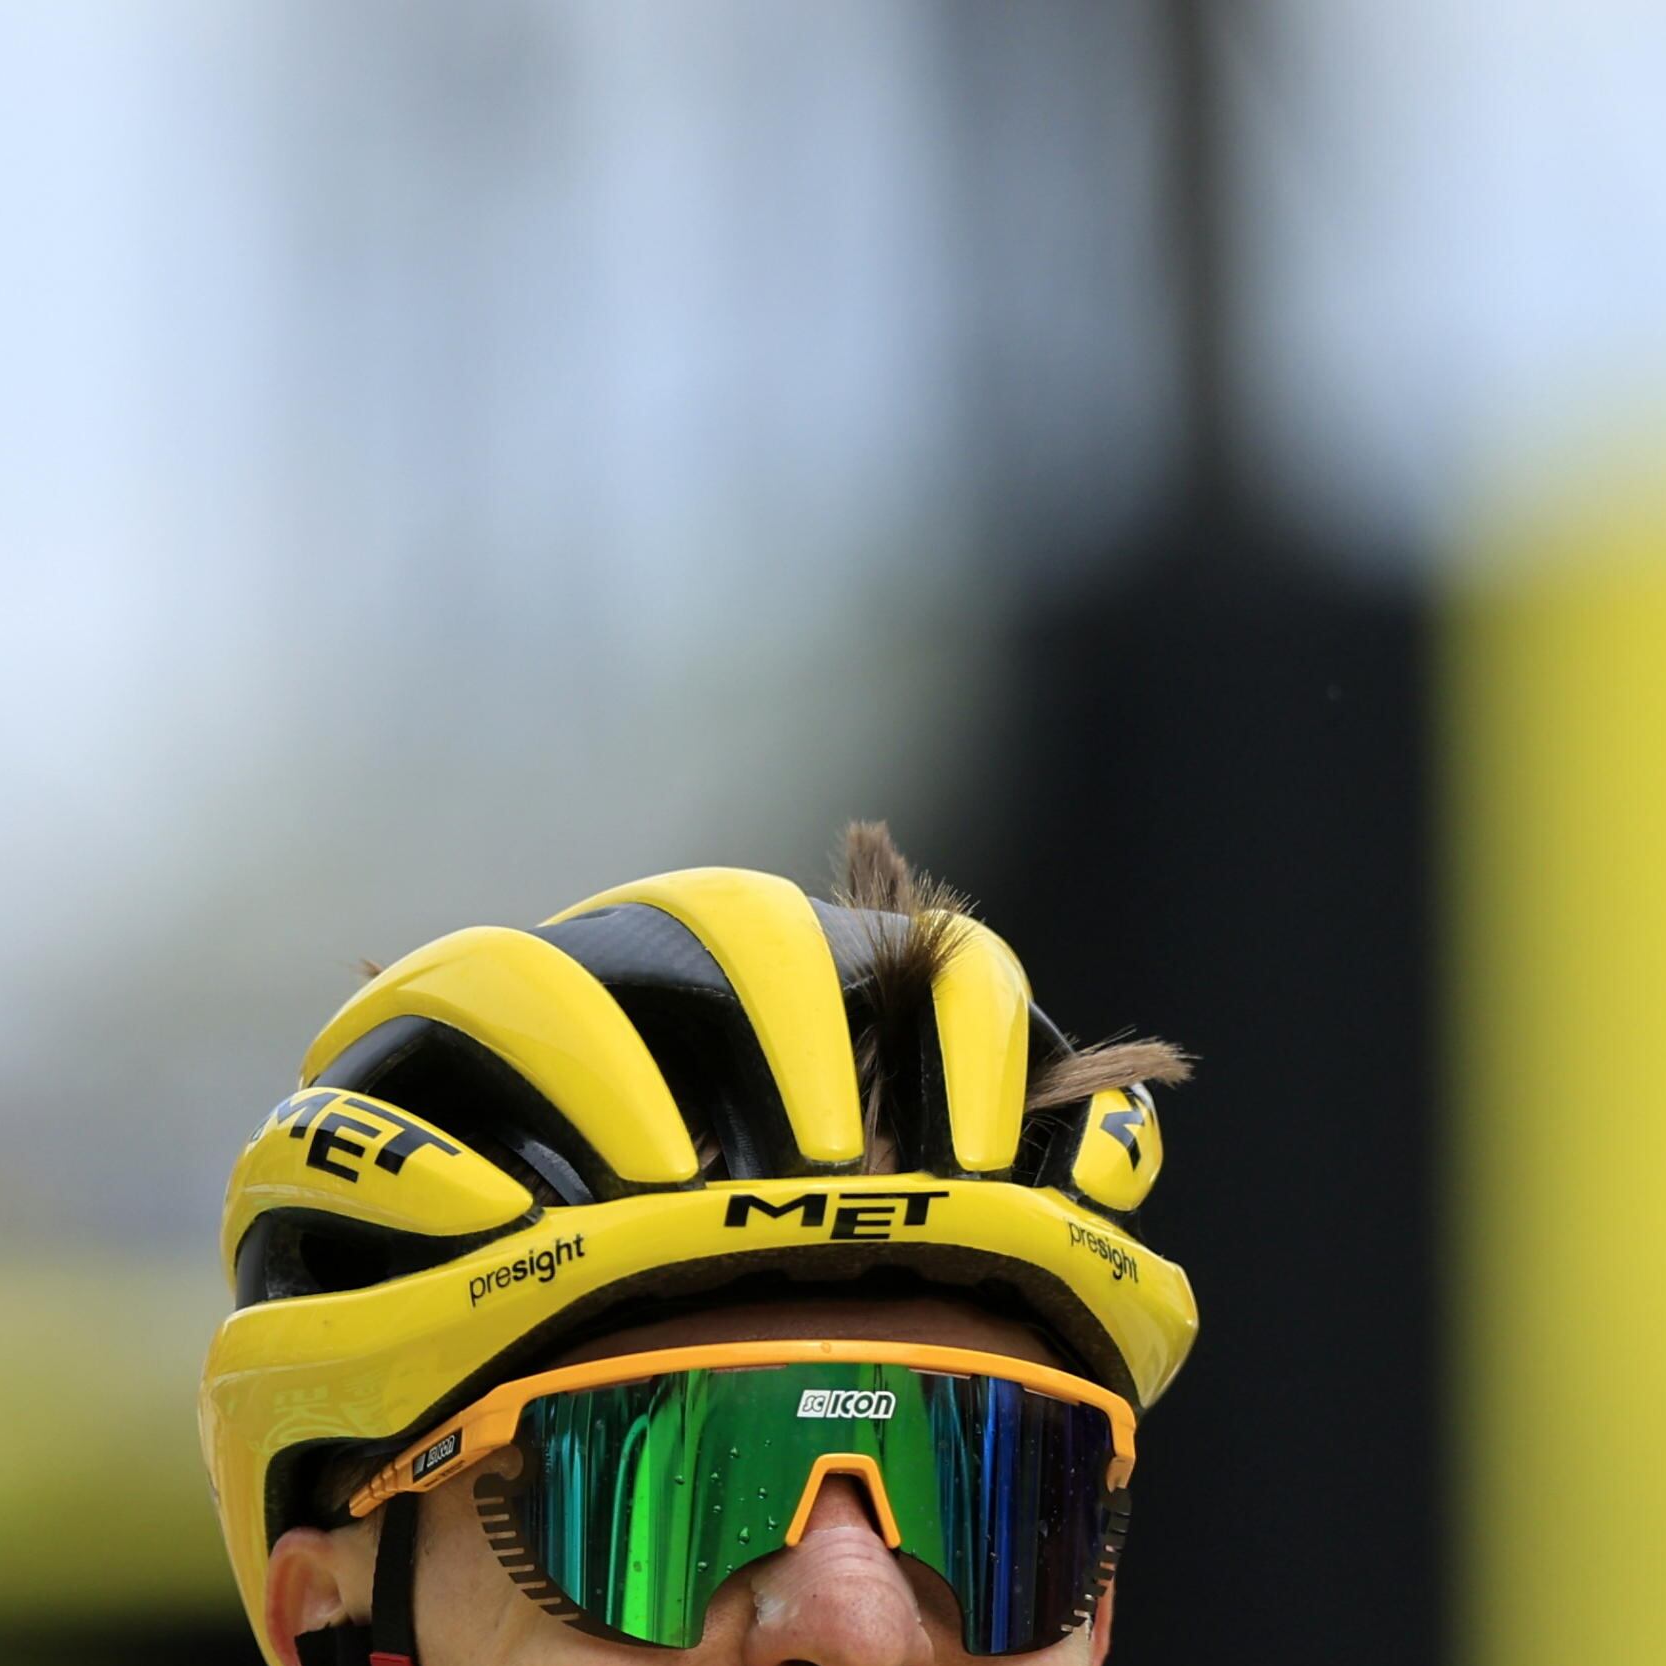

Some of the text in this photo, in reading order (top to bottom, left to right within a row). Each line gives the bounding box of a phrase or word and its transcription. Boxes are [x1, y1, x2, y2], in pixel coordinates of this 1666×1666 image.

[249, 1092, 462, 1184] MET
[723, 1190, 950, 1241] MET
[468, 1232, 586, 1308] presight
[1067, 1220, 1139, 1284] presight
